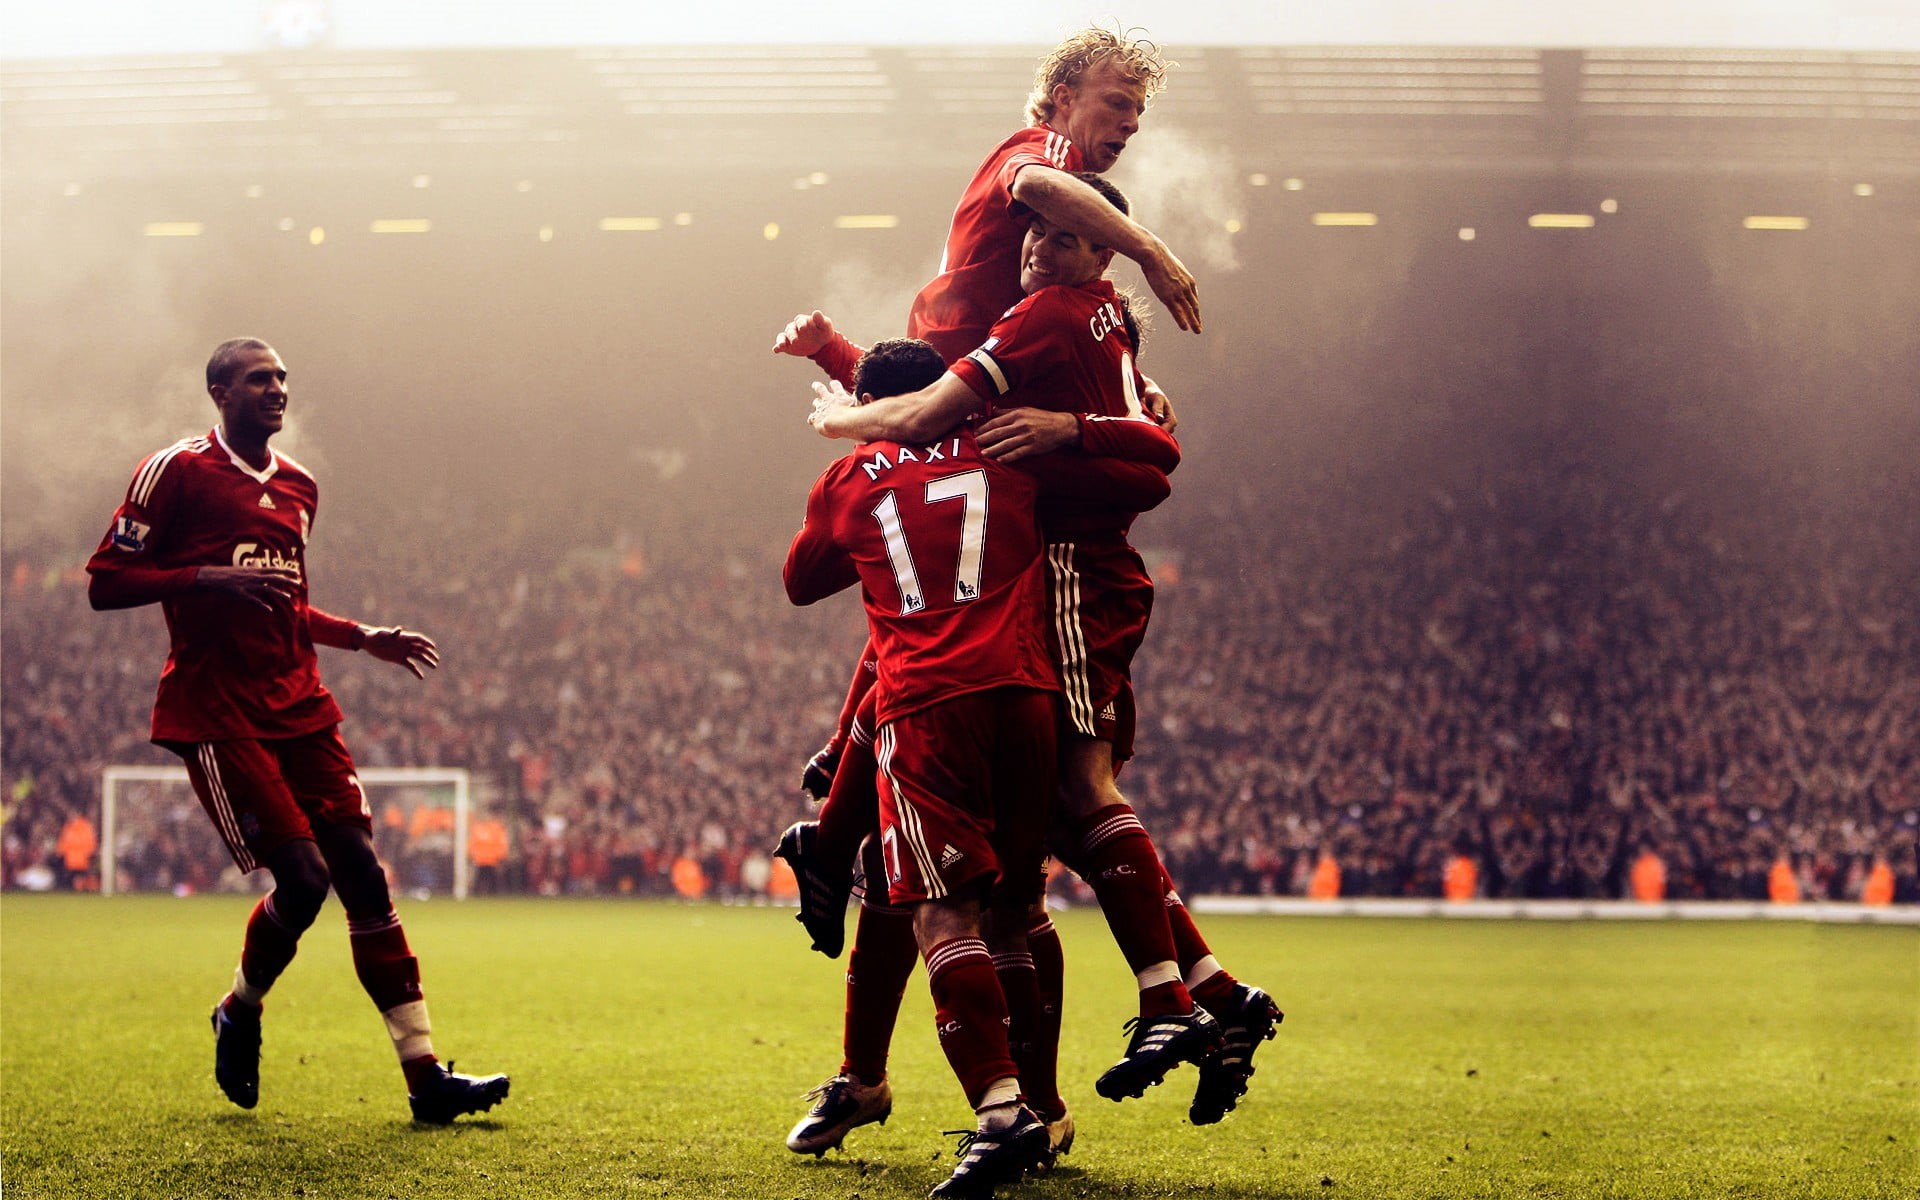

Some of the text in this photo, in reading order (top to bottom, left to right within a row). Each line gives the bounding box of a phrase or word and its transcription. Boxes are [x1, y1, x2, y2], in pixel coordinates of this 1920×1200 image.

[1090, 302, 1125, 342] GER
[862, 438, 960, 481] MAXI
[871, 468, 990, 617] 17
